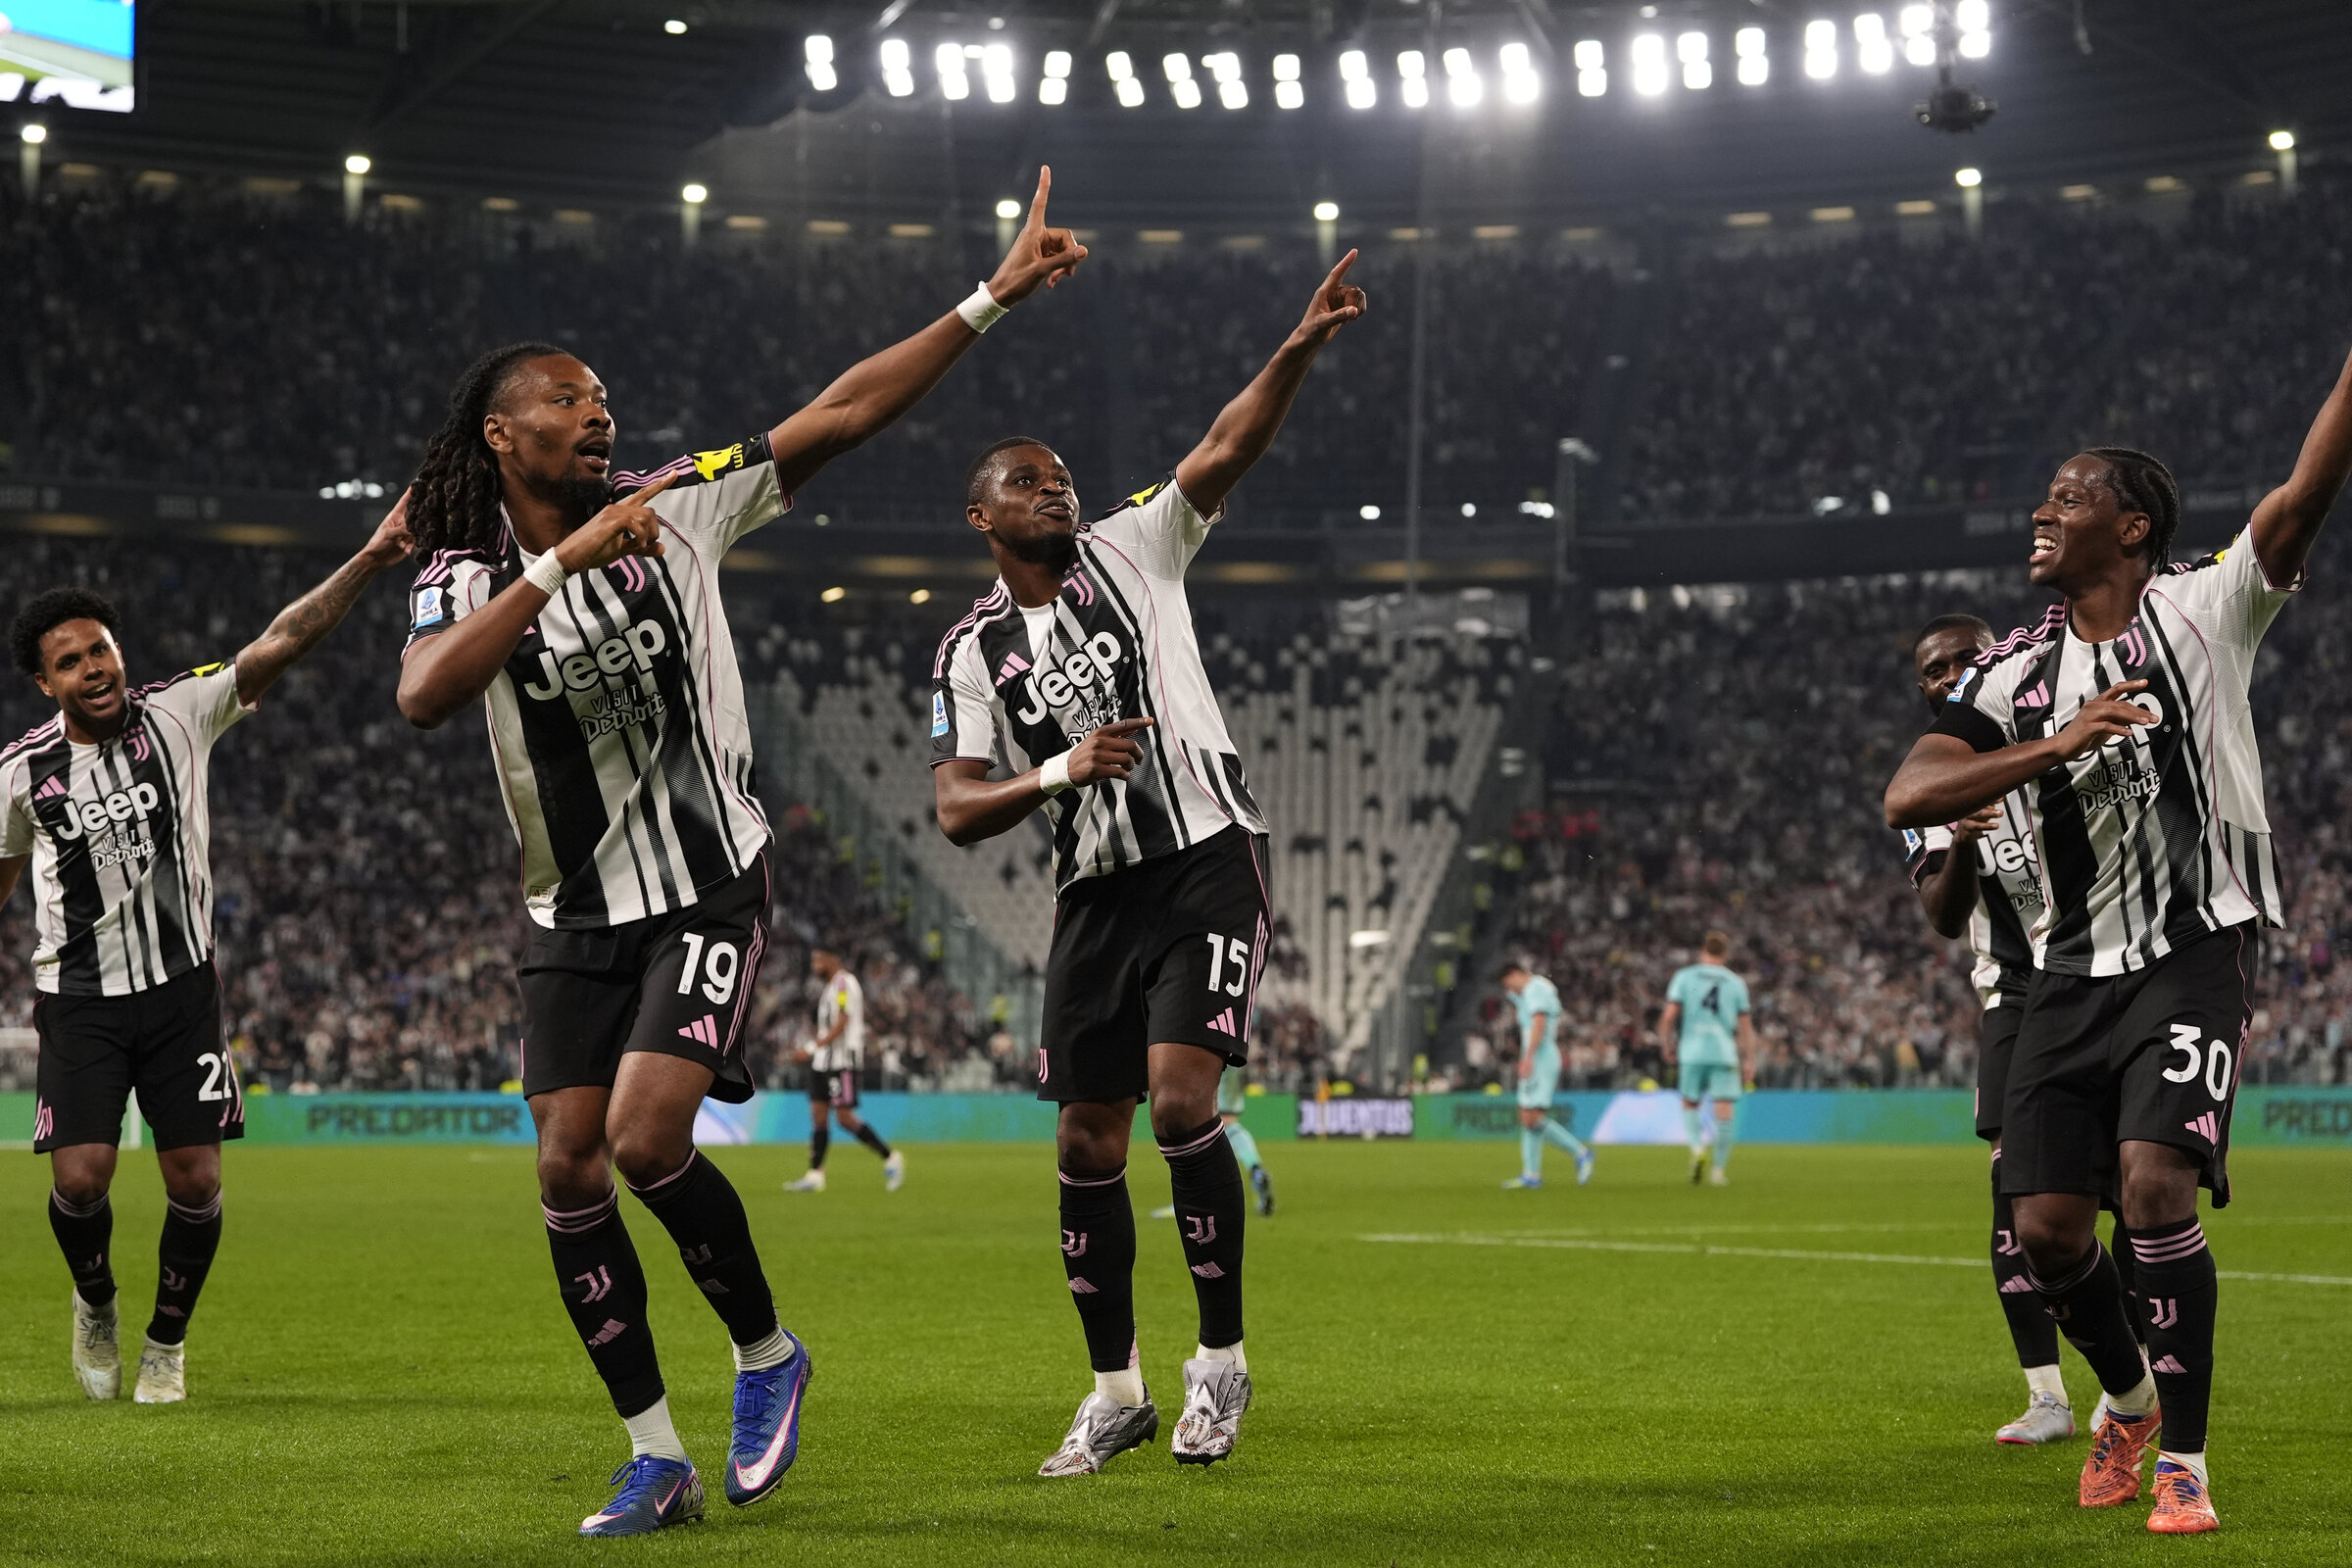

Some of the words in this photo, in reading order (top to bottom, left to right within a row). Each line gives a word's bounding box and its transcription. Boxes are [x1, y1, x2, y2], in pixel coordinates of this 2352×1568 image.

[524, 619, 665, 701] Jeep
[1017, 631, 1121, 725] Jeep
[579, 693, 665, 744] Detroit
[591, 685, 637, 713] VISIT
[2079, 768, 2160, 819] Detroit
[2089, 760, 2133, 786] VISIT
[56, 782, 158, 840] Jeep
[91, 838, 156, 872] Detroit
[103, 829, 135, 851] VISIT
[1978, 831, 2038, 876] Jee
[678, 932, 738, 1004] 19
[1206, 932, 1249, 997] 15
[1701, 985, 1719, 1016] 4
[2162, 1023, 2231, 1102] 30
[308, 1104, 521, 1136] PREDATOR
[1299, 1099, 1413, 1135] JUVENTUS
